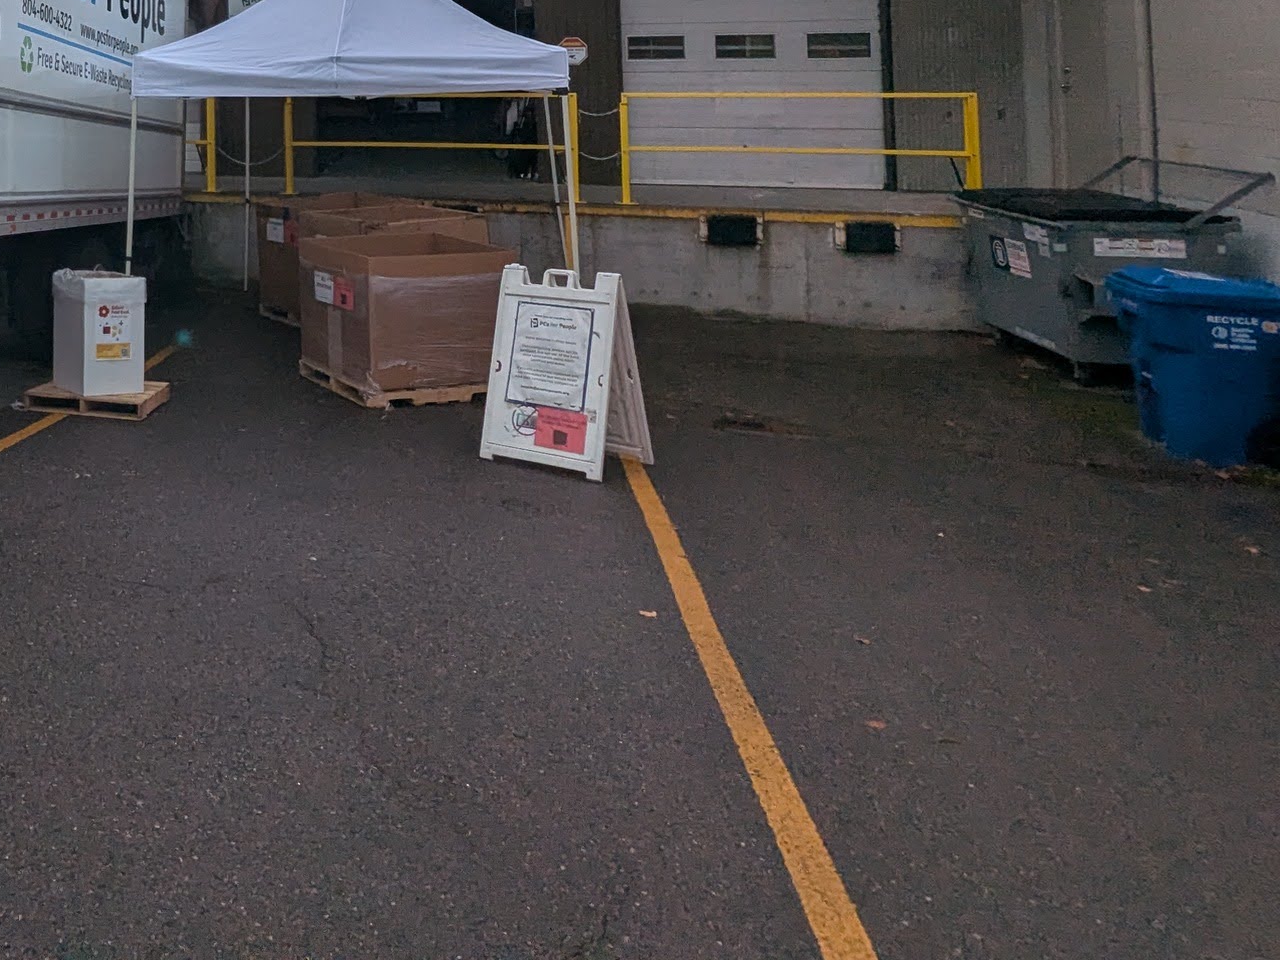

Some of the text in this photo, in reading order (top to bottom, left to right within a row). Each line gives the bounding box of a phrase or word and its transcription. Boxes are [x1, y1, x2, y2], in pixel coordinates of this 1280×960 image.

[37, 47, 132, 95] Free & Secure E-Waste Recycling
[1206, 315, 1259, 326] RECYCLE
